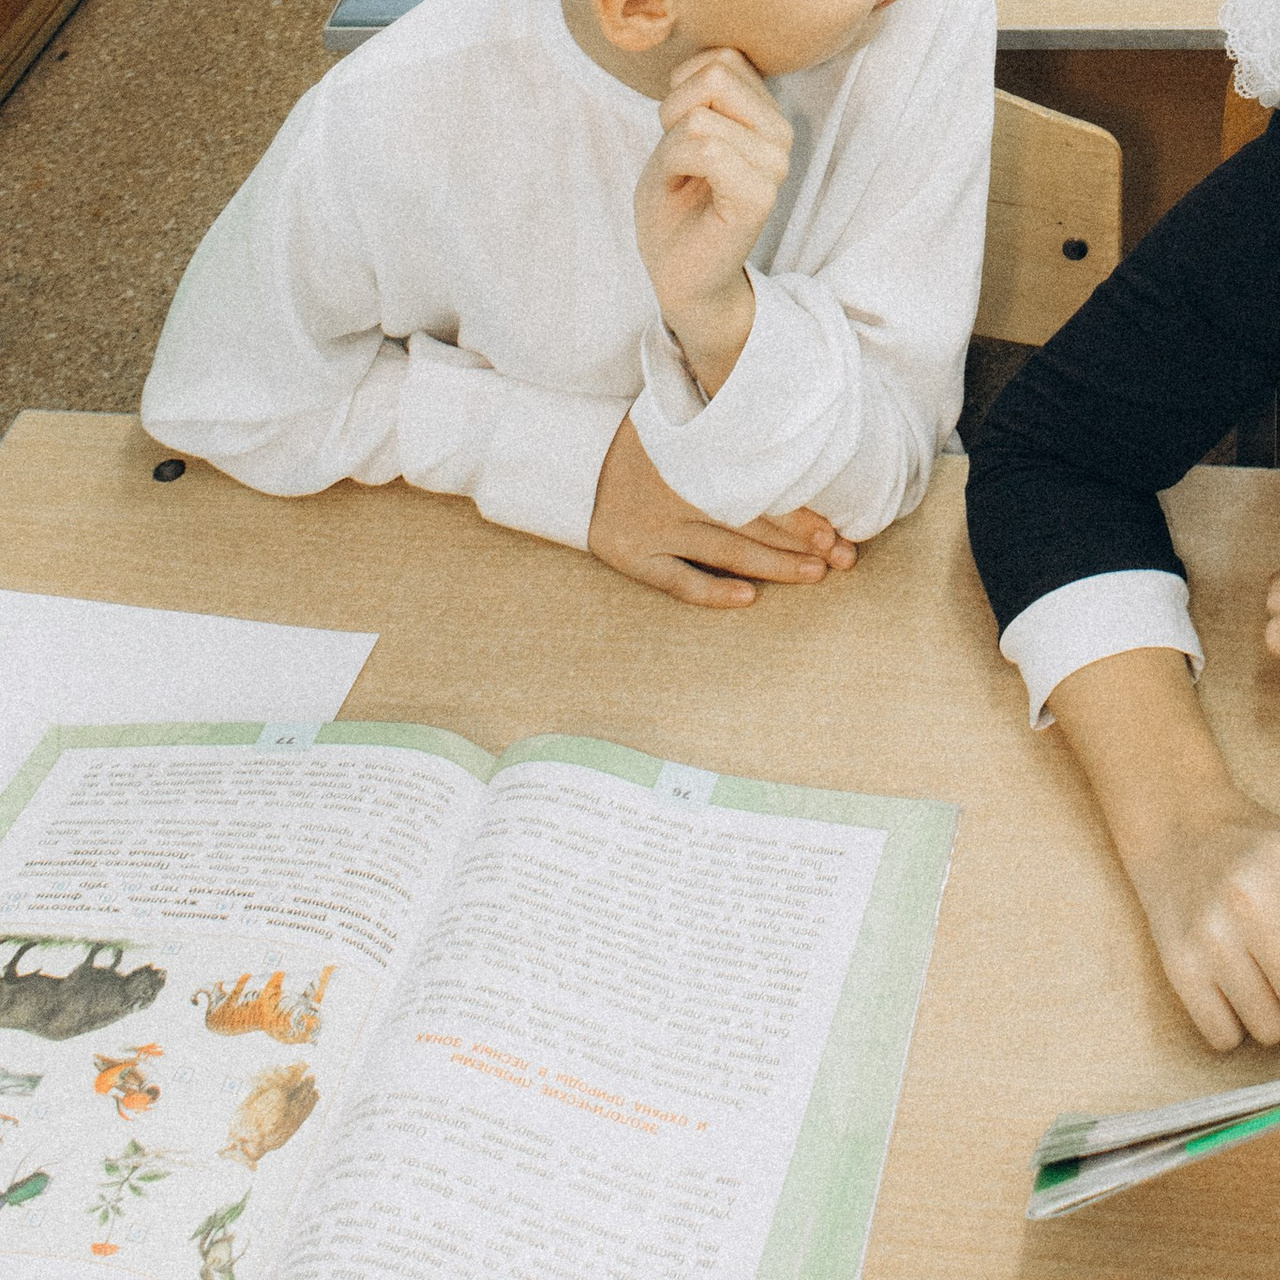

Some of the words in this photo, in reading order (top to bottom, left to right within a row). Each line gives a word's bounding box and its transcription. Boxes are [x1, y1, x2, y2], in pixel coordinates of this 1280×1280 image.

[275, 734, 296, 746] 77
[673, 787, 691, 800] 76
[24, 859, 170, 870] Приокско-Террасный
[79, 881, 109, 889] зубр
[150, 884, 179, 894] тигр
[36, 892, 82, 900] филин
[188, 887, 254, 899] амурский
[128, 897, 198, 906] жук-олень
[28, 904, 120, 914] жук-красотел
[244, 904, 328, 922] реликтовый
[161, 911, 228, 922] женьшень
[293, 896, 399, 941] утка-мандаринка
[266, 919, 334, 940] башмачок
[339, 921, 393, 954] дровосек
[415, 1032, 463, 1047] ЗОНАХ
[471, 1043, 530, 1070] ЛЕСНЫХ
[450, 1053, 533, 1089] ПРОБЛЕМЫ
[537, 1066, 548, 1078] В
[555, 1073, 625, 1108] ПРИРОДЫ
[538, 1085, 661, 1137] ЭКОЛОГИЧЕСКИЕ
[634, 1100, 689, 1127] ОХРАНА
[696, 1121, 709, 1132] И
